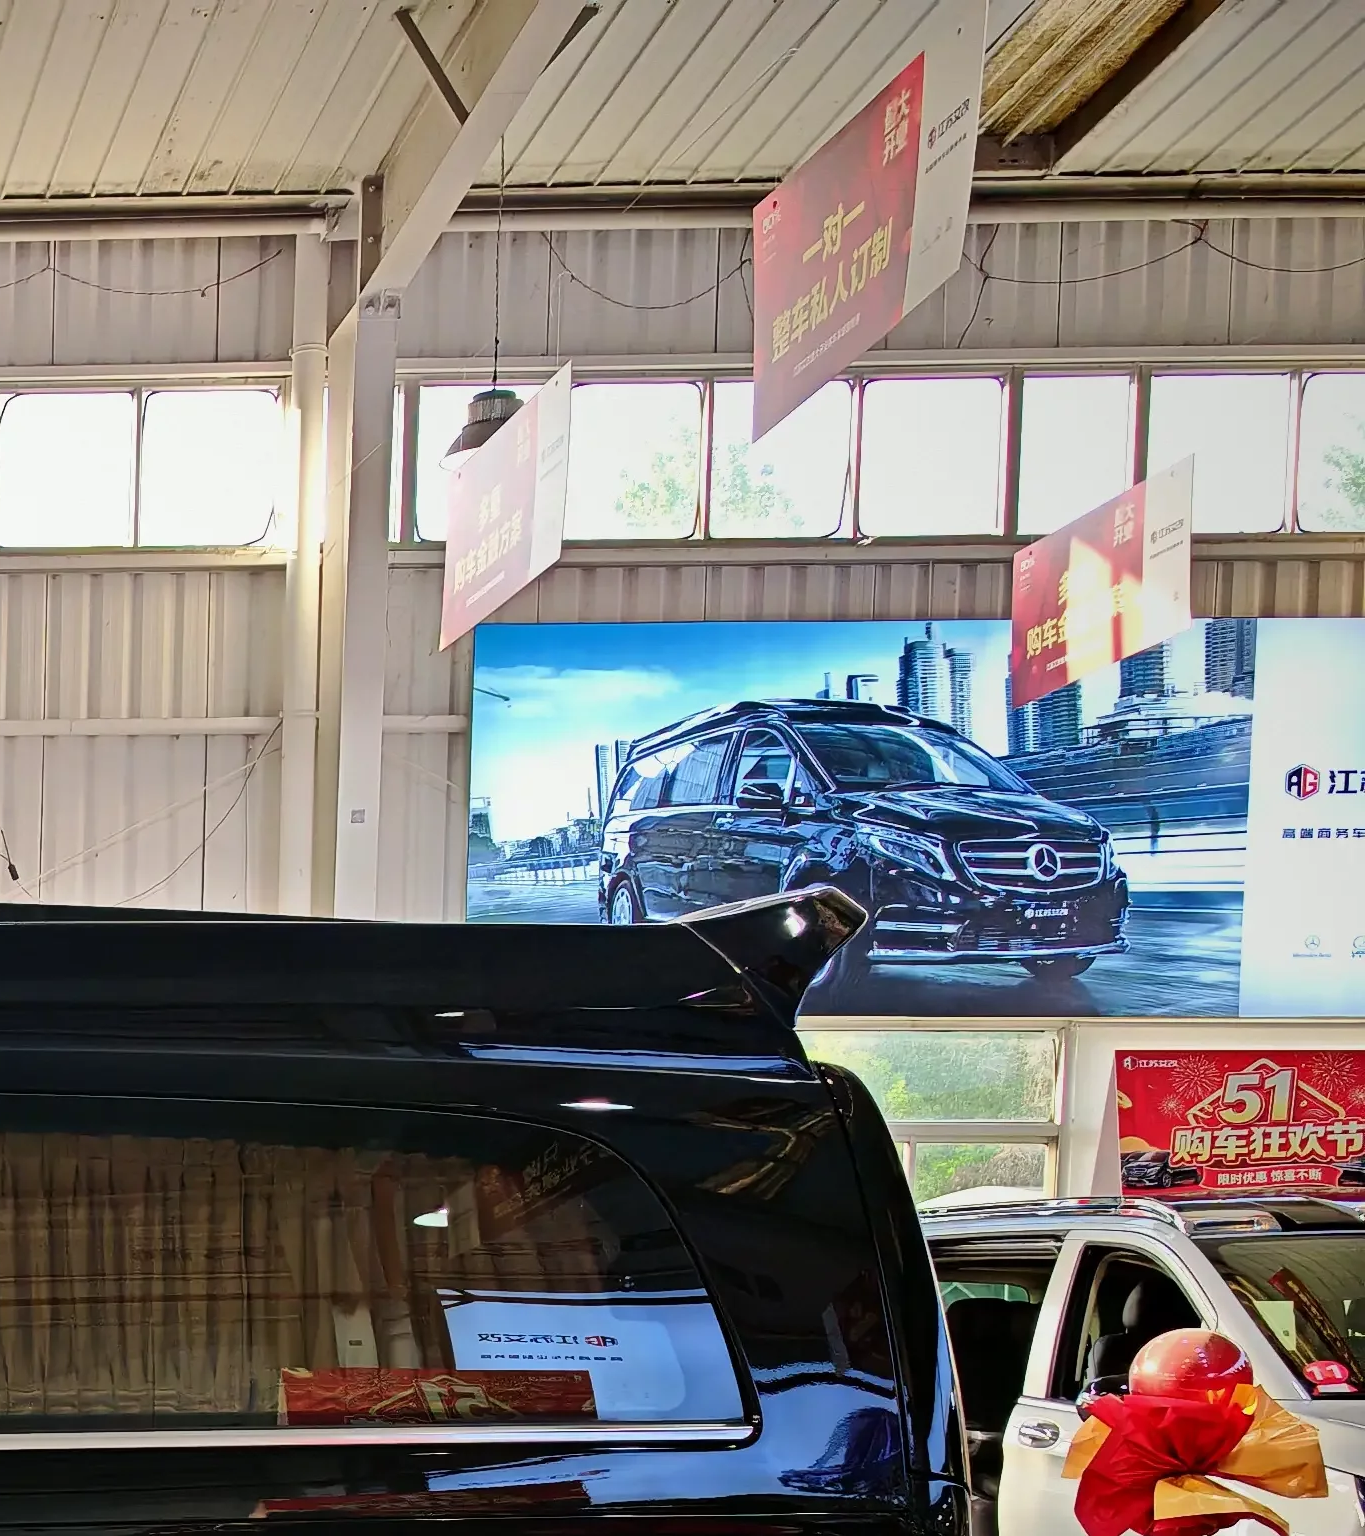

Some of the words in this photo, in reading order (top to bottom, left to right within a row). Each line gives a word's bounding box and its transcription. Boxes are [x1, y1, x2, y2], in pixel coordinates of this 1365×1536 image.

[802, 200, 866, 264] 一对一
[771, 215, 894, 364] 整车私人订制
[1328, 770, 1365, 794] 江
[1282, 828, 1365, 839] 高端商务车
[1220, 1068, 1296, 1124] 51
[1173, 1120, 1365, 1162] 购车狂欢节
[1217, 1170, 1268, 1186] 限时优惠
[1270, 1168, 1322, 1182] 惊喜不断
[1306, 1364, 1343, 1381] 11
